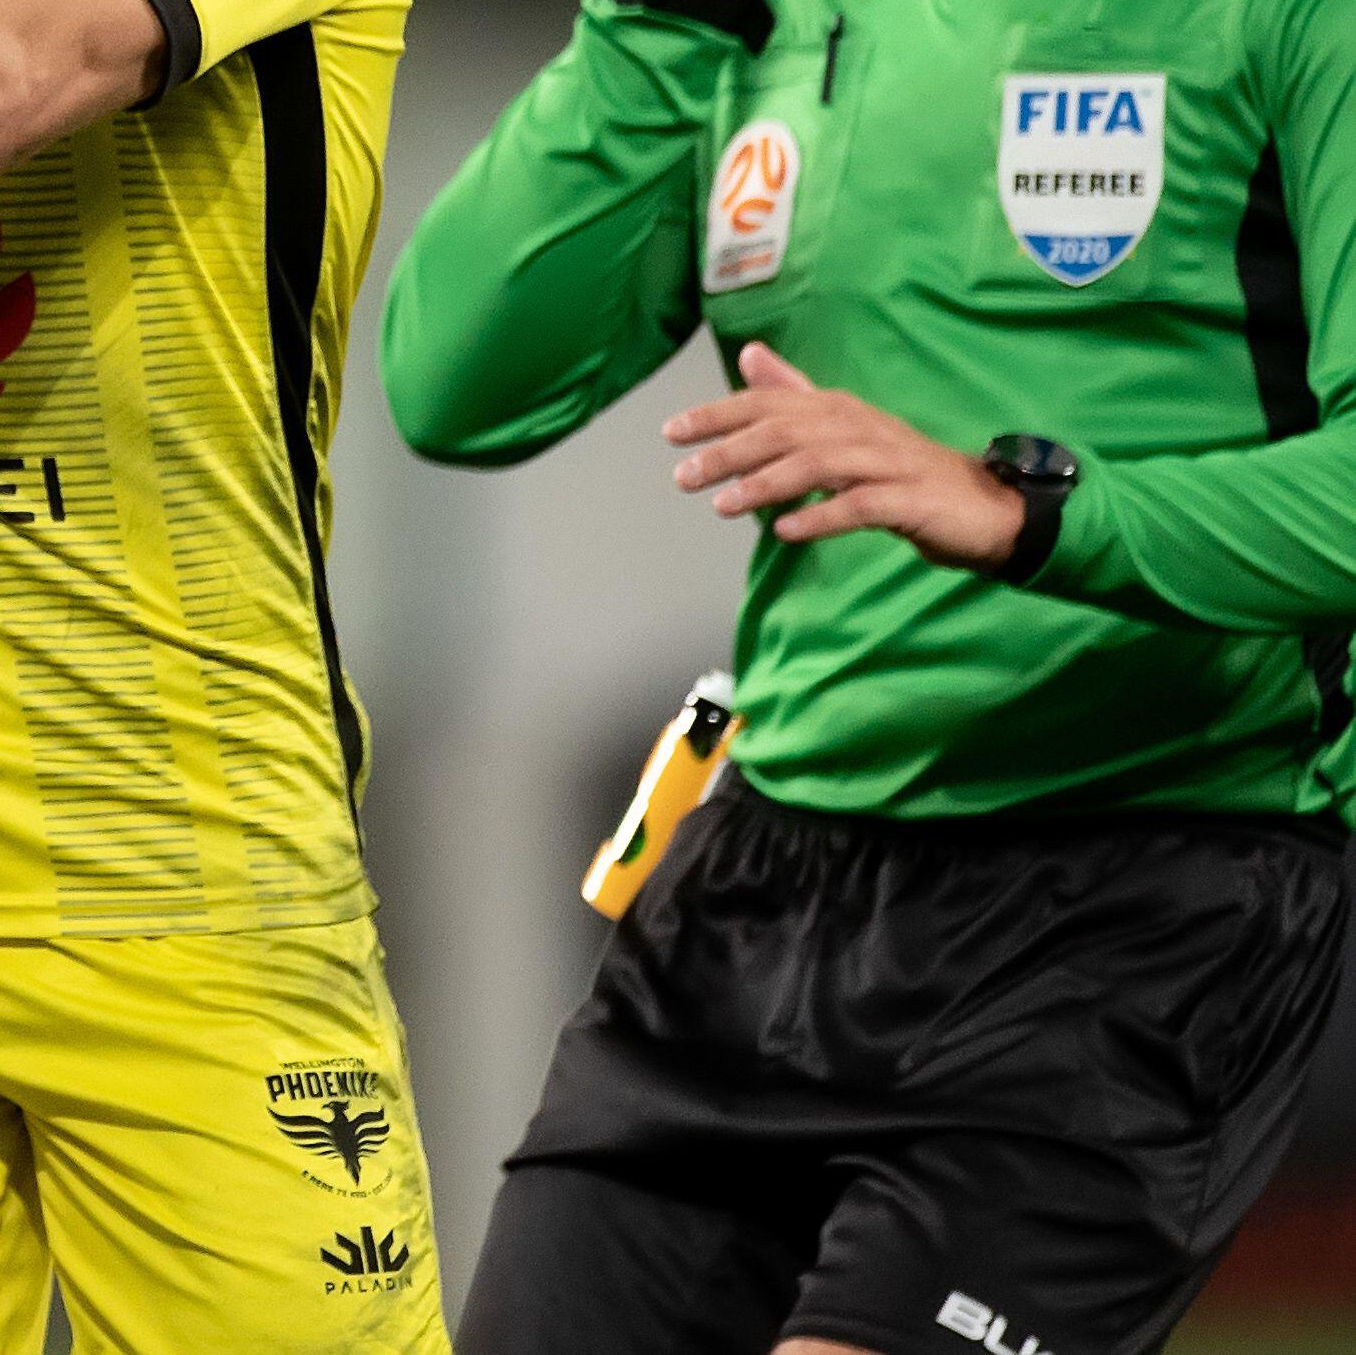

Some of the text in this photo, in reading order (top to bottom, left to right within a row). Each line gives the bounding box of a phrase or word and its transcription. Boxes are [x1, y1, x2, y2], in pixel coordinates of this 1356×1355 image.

[1017, 91, 1144, 134] FIFA
[1014, 172, 1145, 195] REFEREE
[1047, 238, 1112, 265] 2020
[324, 1276, 413, 1295] PALADIN
